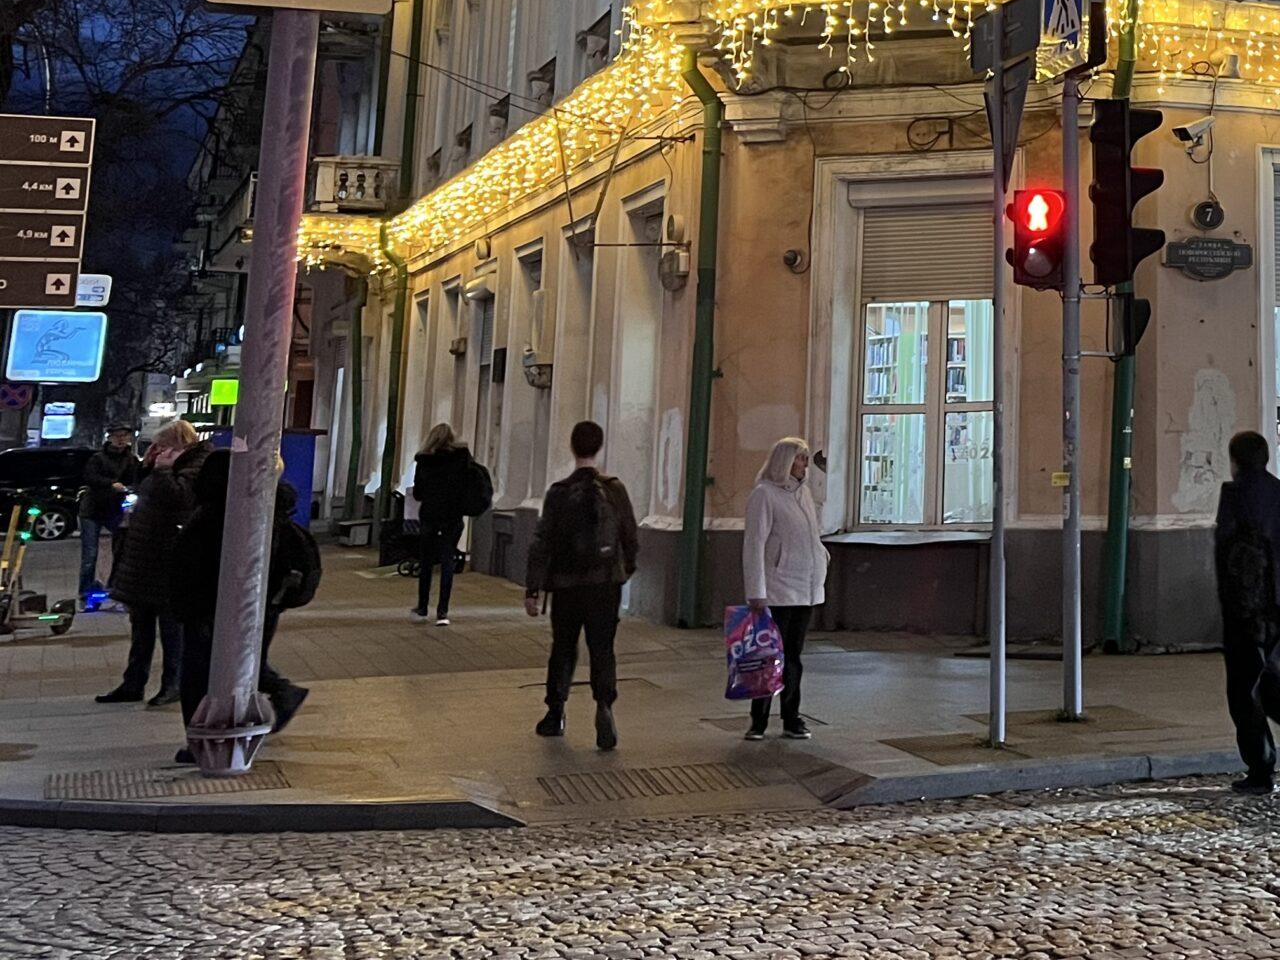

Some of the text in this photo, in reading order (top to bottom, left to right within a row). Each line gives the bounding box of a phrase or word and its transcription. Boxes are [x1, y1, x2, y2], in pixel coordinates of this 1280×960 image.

[29, 134, 58, 144] 100 м
[22, 181, 53, 191] 4,4 км
[1205, 208, 1213, 222] 7
[17, 229, 48, 239] 4,9 км
